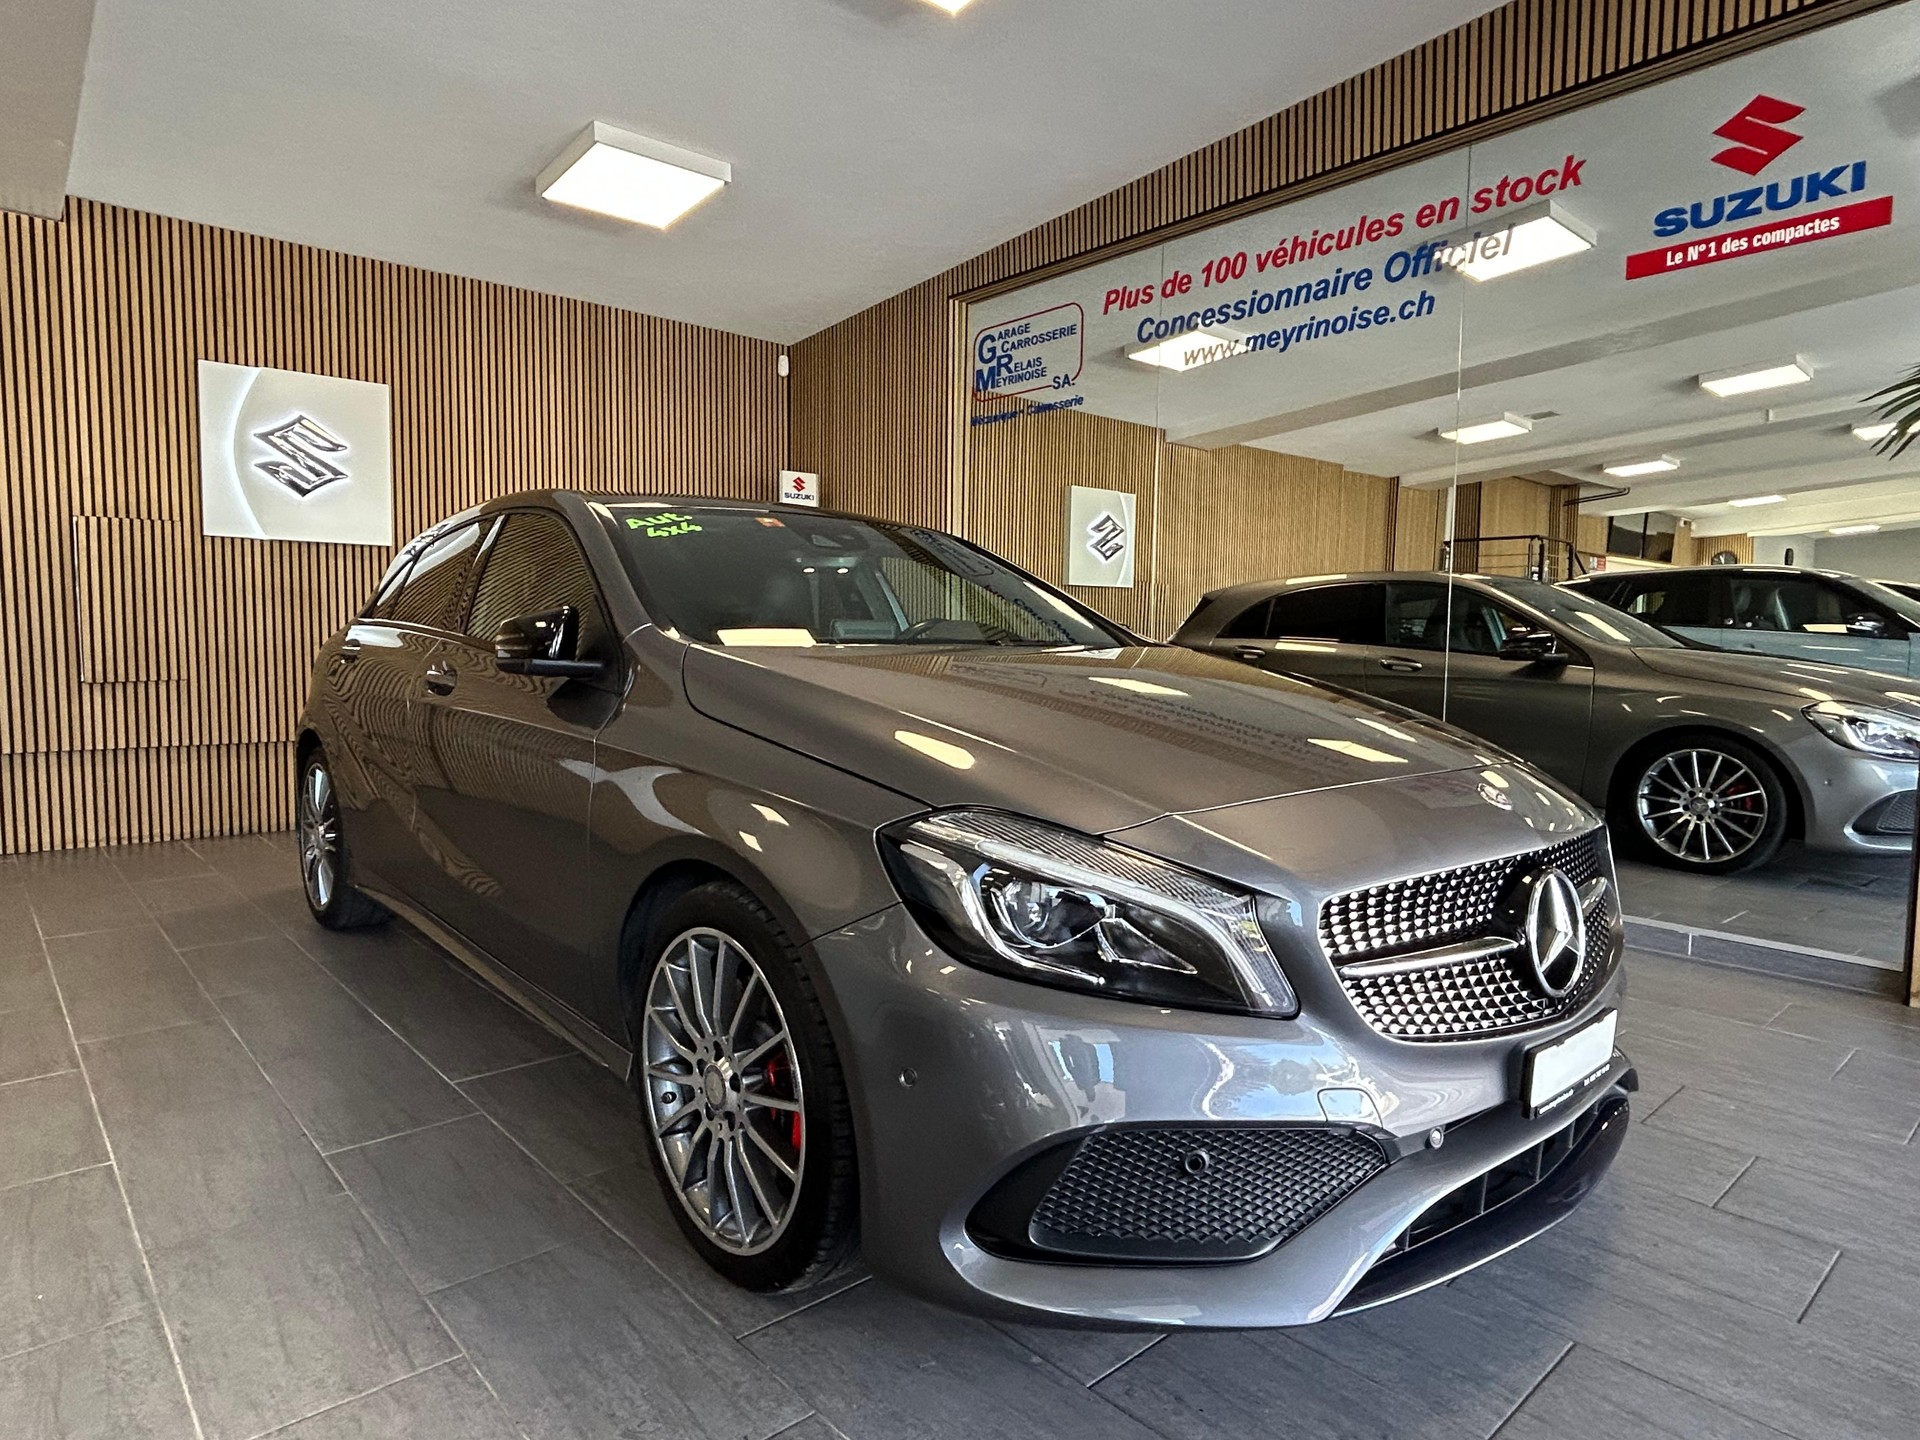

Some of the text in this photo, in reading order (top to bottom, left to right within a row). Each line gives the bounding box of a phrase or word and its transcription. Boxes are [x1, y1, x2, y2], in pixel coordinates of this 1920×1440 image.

[1653, 160, 1866, 237] SUZUKI
[1103, 154, 1587, 315] Plus de 100 véhicules en stock
[1666, 250, 1683, 266] Le
[1721, 236, 1749, 255] des
[1753, 216, 1840, 246] compactes
[1137, 222, 1516, 343] Concessionnaire Officiel
[1001, 324, 1078, 353] CARROSSERIE
[1184, 290, 1435, 365] www.meyrinoise.ch
[975, 367, 1048, 392] MEYRINOISE
[996, 353, 1043, 377] RELAIS
[784, 492, 815, 501] SUZUKI
